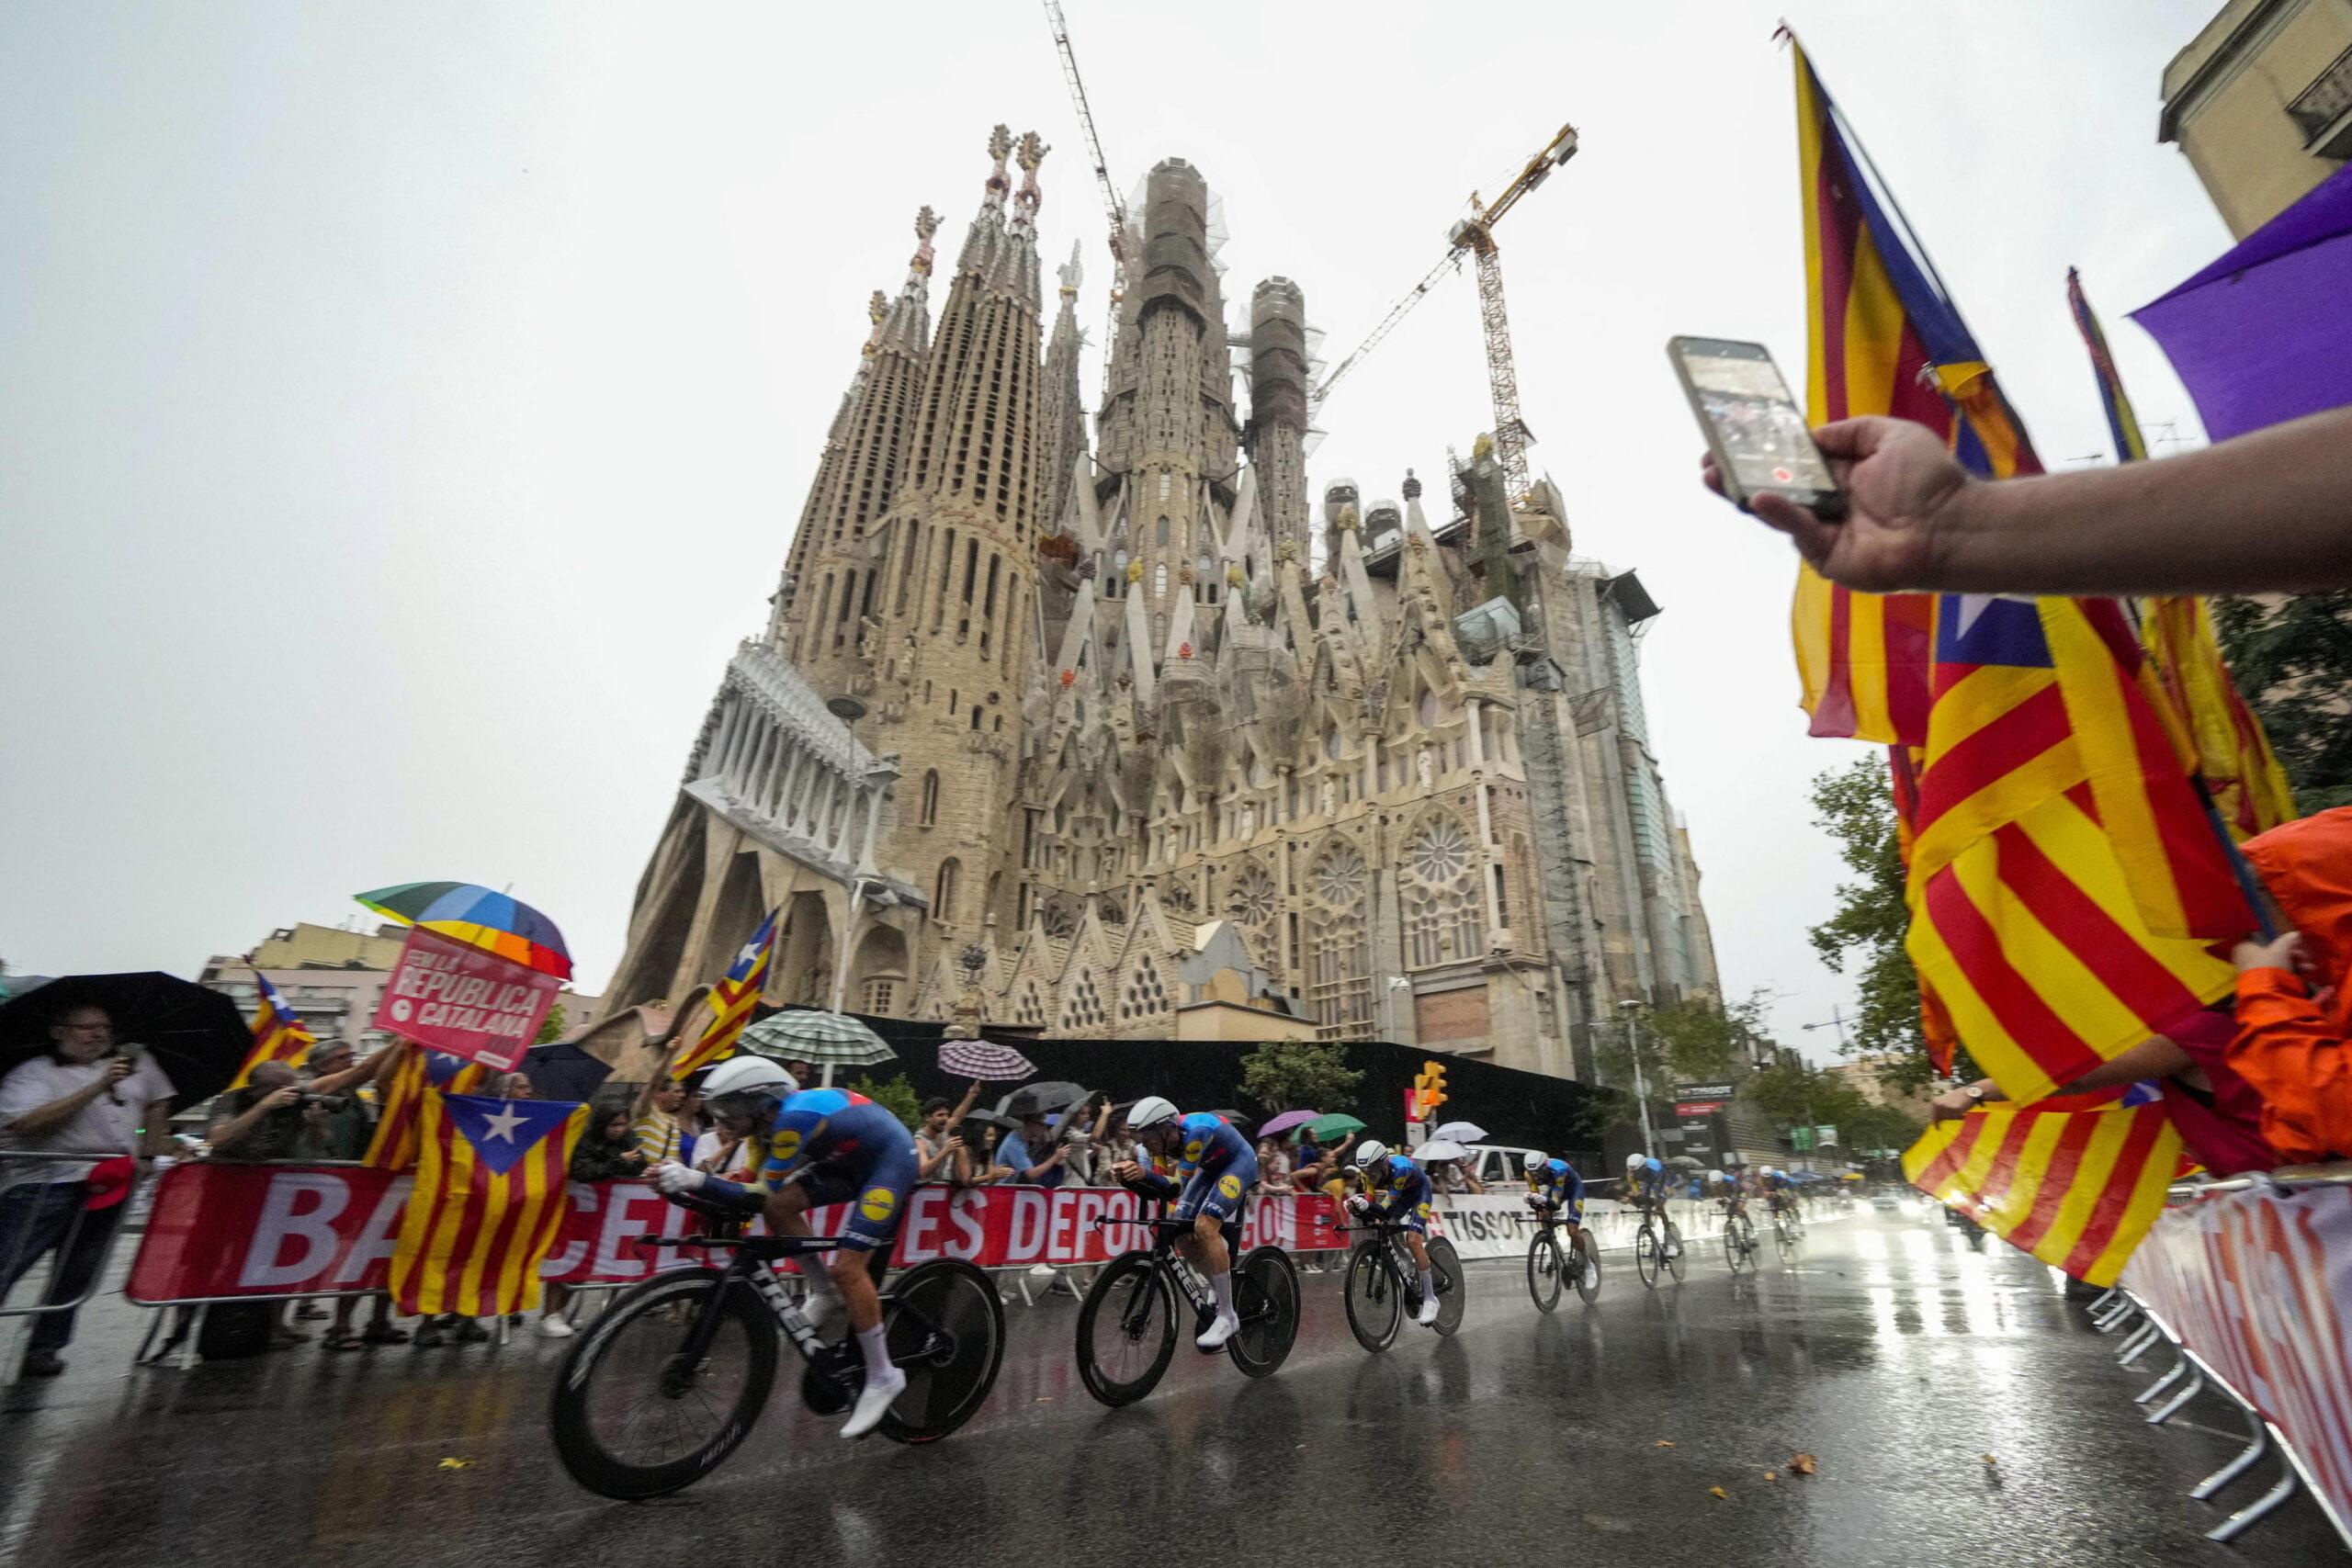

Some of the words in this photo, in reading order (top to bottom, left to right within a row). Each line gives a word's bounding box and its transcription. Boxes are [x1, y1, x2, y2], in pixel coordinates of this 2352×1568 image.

[392, 964, 542, 1017] REPÚBLICA
[416, 1001, 532, 1039] CATALANA
[1442, 1210, 1523, 1241] TISSOT
[1167, 1245, 1207, 1312] TREK
[749, 1259, 828, 1358] TREK
